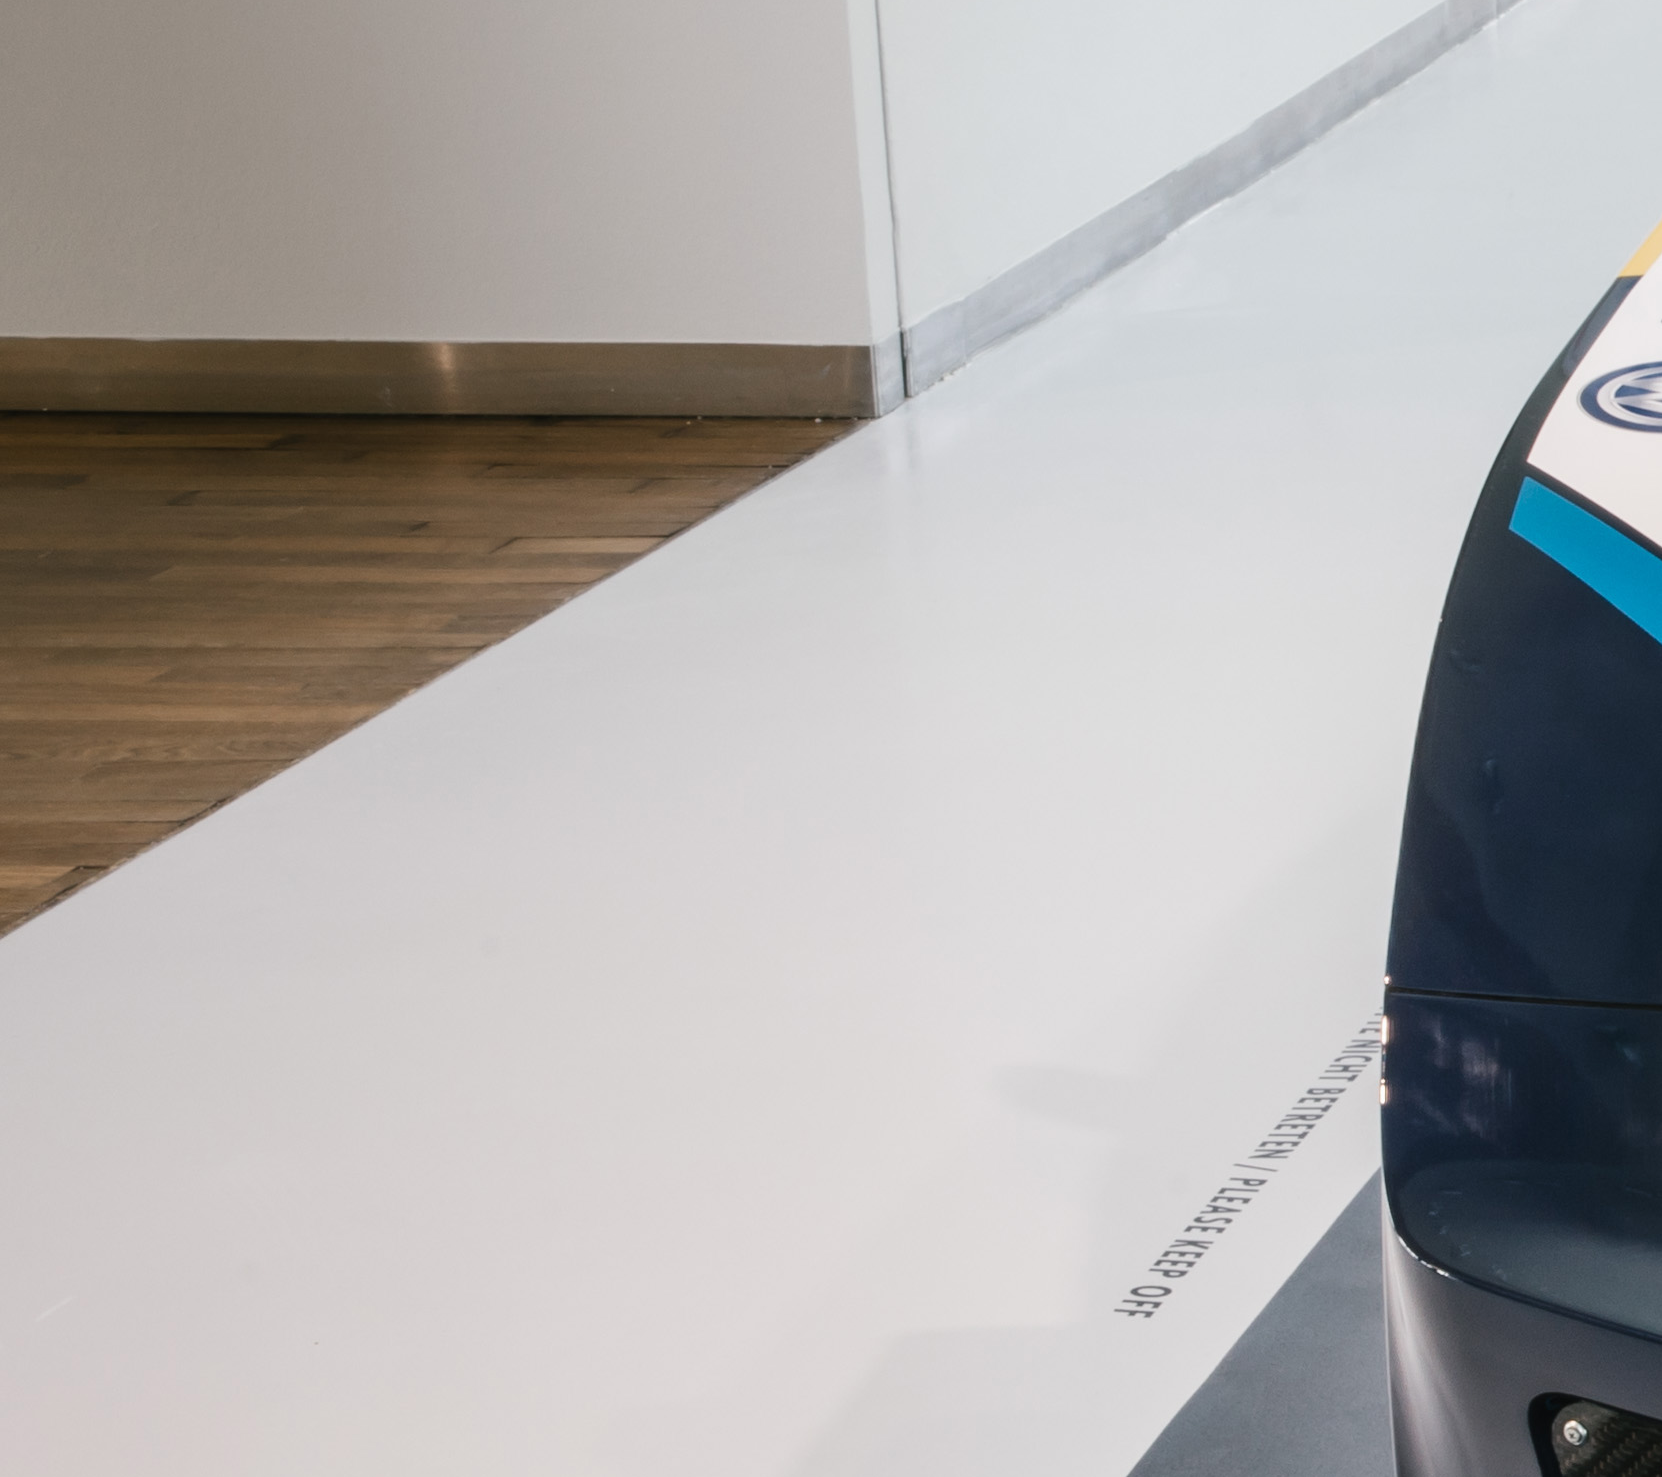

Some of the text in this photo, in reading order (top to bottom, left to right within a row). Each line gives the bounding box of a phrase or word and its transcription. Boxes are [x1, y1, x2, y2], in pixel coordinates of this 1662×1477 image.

[1318, 1038, 1381, 1082] NICHT
[1248, 1087, 1347, 1160] BETRETEN
[1184, 1176, 1268, 1234] PLEASE
[1148, 1238, 1214, 1280] KEEP
[1113, 1284, 1173, 1319] OFF
